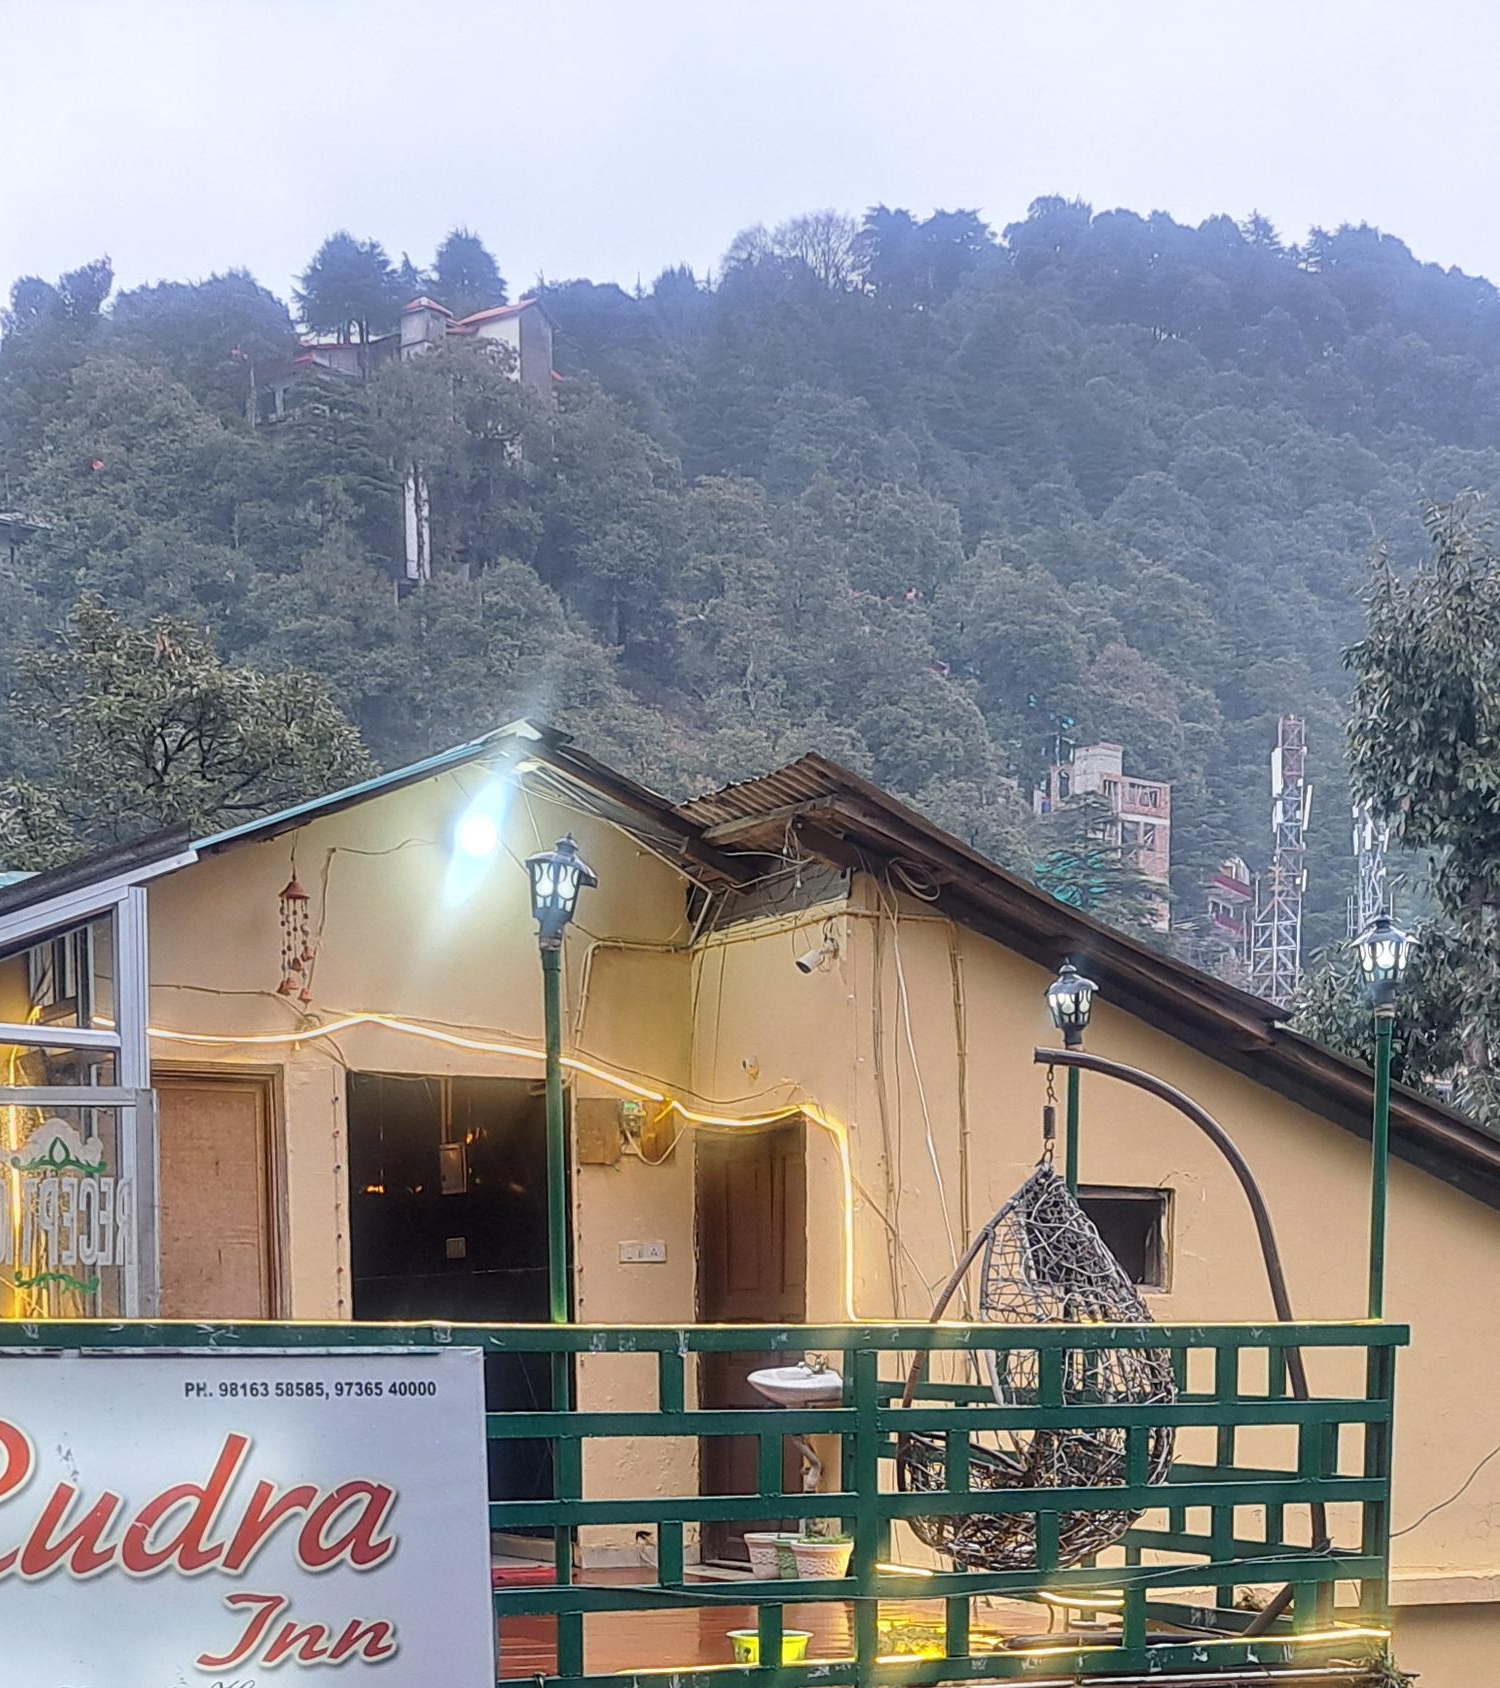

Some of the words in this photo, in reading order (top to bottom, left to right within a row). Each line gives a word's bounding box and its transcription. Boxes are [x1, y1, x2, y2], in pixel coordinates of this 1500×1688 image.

[184, 1382, 214, 1397] PH.
[218, 1382, 270, 1398] 98163
[274, 1381, 330, 1400] 58585,
[334, 1381, 384, 1397] 97365
[388, 1381, 437, 1396] 40000
[194, 1591, 396, 1669] Inn
